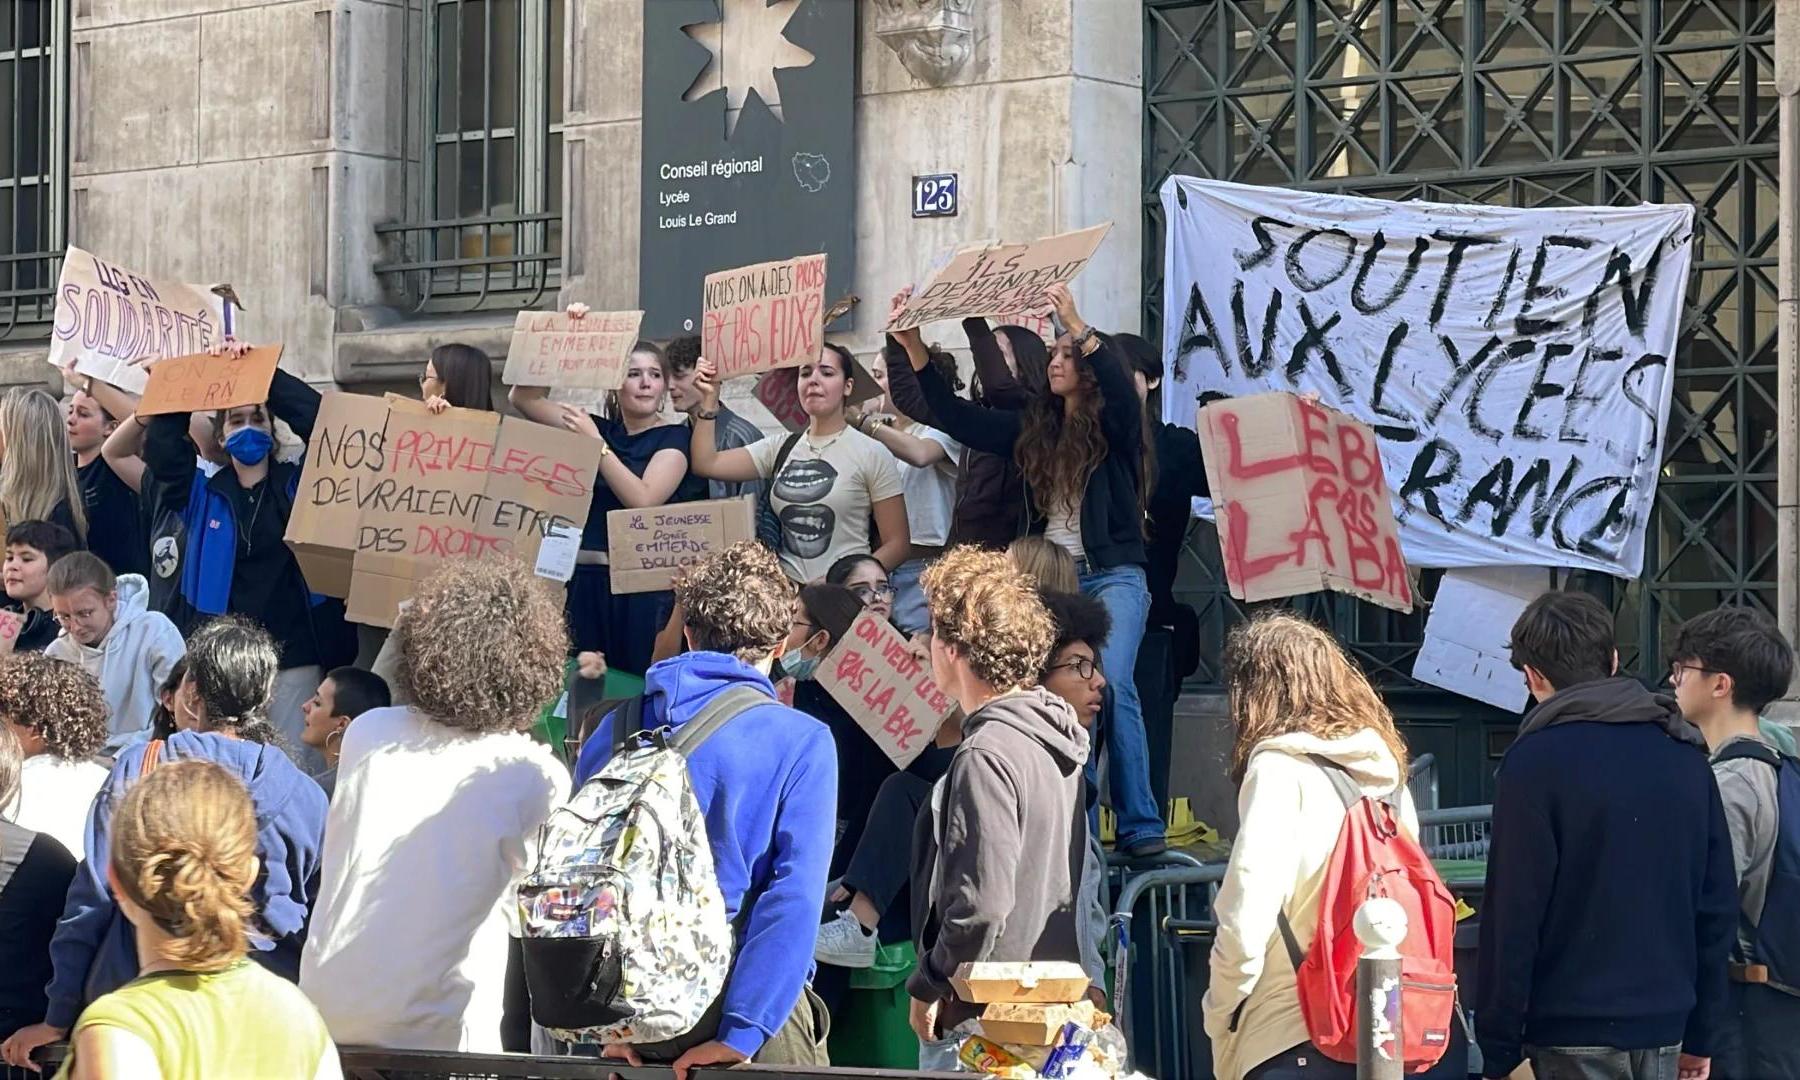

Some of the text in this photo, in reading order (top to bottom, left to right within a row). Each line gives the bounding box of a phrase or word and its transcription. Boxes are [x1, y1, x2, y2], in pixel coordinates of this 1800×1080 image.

[660, 156, 763, 180] Conseil régional
[659, 190, 690, 206] Lycée
[915, 179, 953, 212] 123
[659, 211, 737, 229] Louis Le Grand
[922, 258, 1088, 299] DEMANDENT
[966, 250, 1026, 282] ILS
[1233, 215, 1664, 341] SOUTIEN
[129, 275, 160, 302] EN
[738, 271, 756, 304] ON
[759, 270, 768, 299] A
[771, 265, 793, 296] DES
[55, 284, 213, 361] SOLIDARITÉ
[531, 318, 555, 332] LA
[704, 293, 821, 374] PK PAS EUX?
[1172, 279, 1354, 401] AUX
[540, 335, 616, 356] EMMERDE
[163, 359, 208, 382] ON
[528, 360, 546, 375] LE
[203, 378, 238, 407] RN
[1371, 321, 1668, 464] LYCEES
[316, 409, 588, 498] NOS PRIVILEGES
[1220, 396, 1338, 479] LE
[312, 476, 575, 540] DEVRAIENT ETRE
[654, 514, 713, 527] JEUNESSE
[1309, 478, 1378, 537] PAS
[358, 526, 407, 552] DES
[635, 540, 710, 553] EMMERDE
[1227, 500, 1335, 584] LA
[856, 616, 886, 648] ON
[882, 635, 923, 681] VEUT
[915, 676, 938, 699] LE
[836, 650, 923, 751] PAS LA BAC
